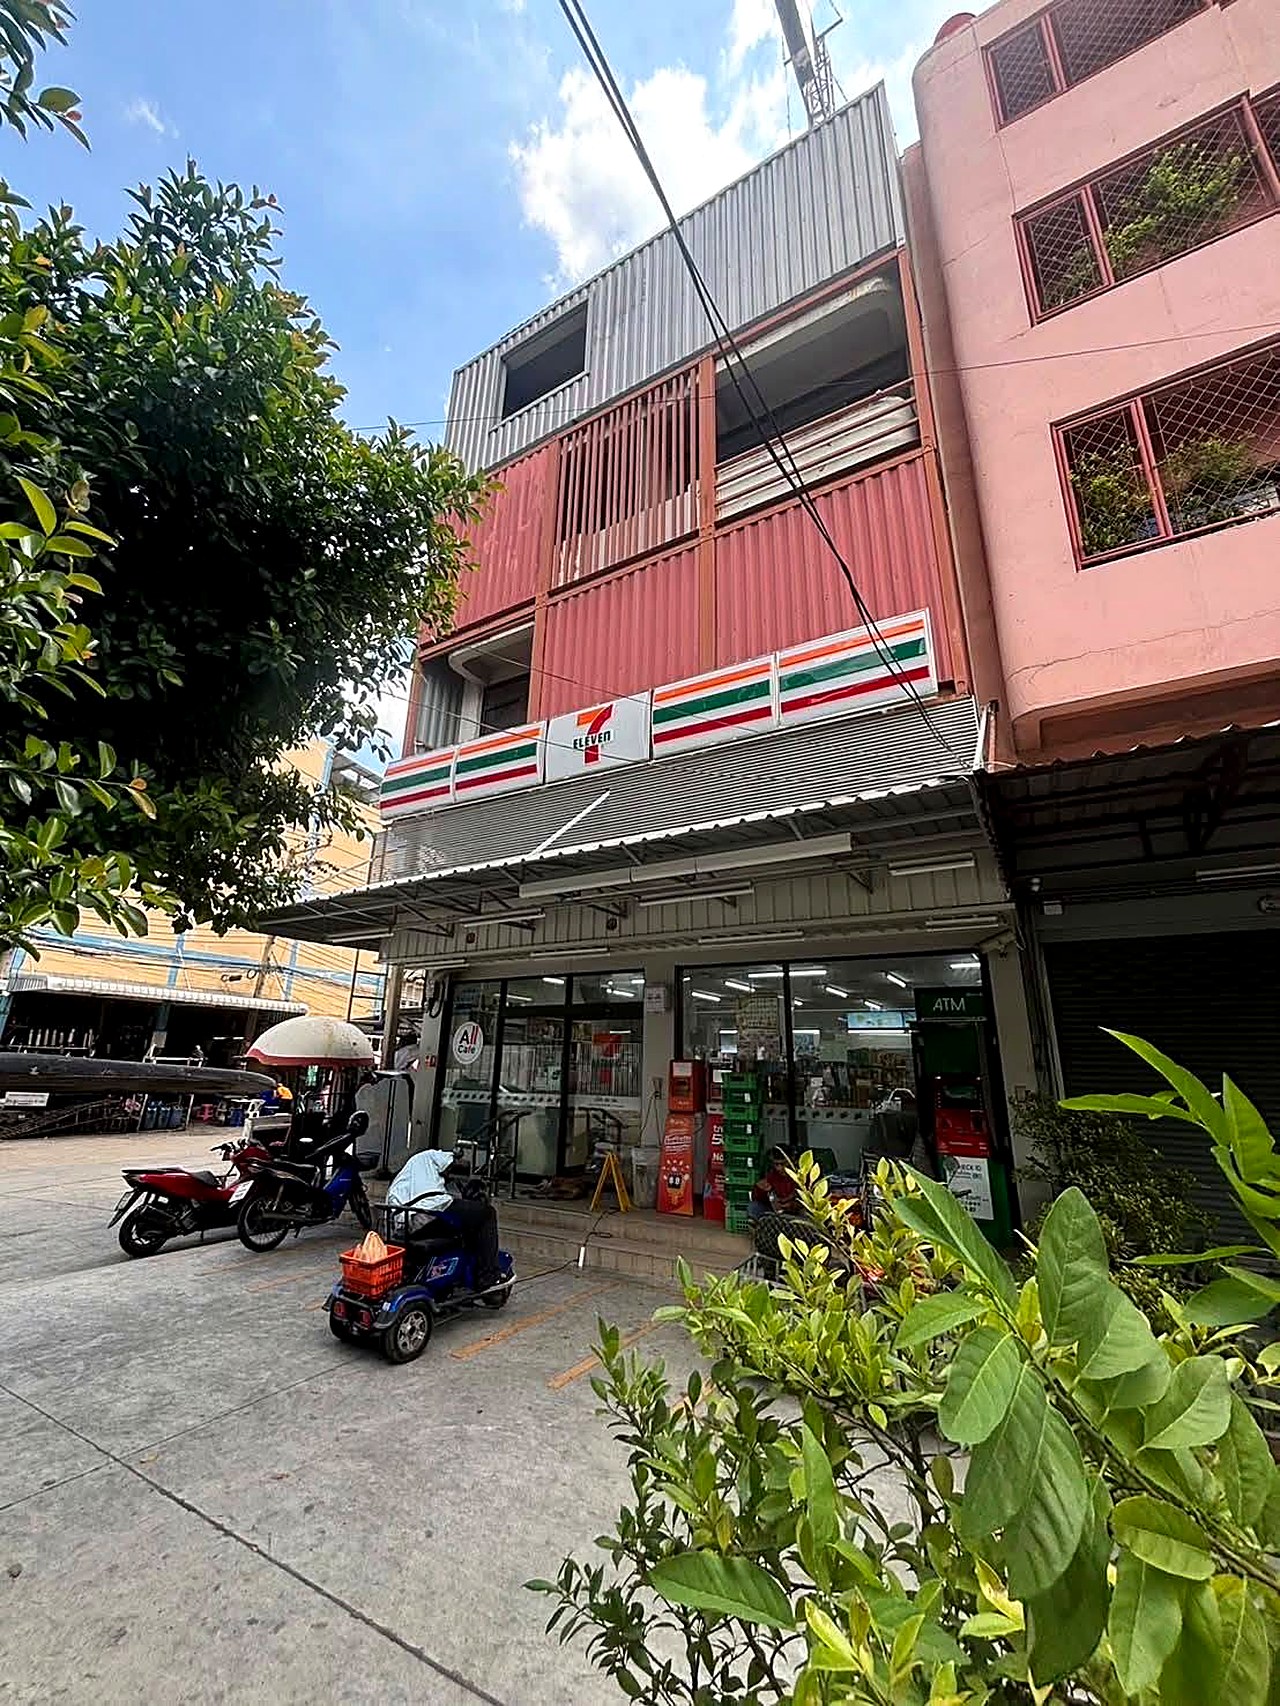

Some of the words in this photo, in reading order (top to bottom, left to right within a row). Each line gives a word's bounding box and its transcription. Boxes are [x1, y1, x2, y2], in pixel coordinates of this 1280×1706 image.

[577, 704, 613, 764] 7
[932, 997, 967, 1012] ATM
[459, 1025, 479, 1045] All
